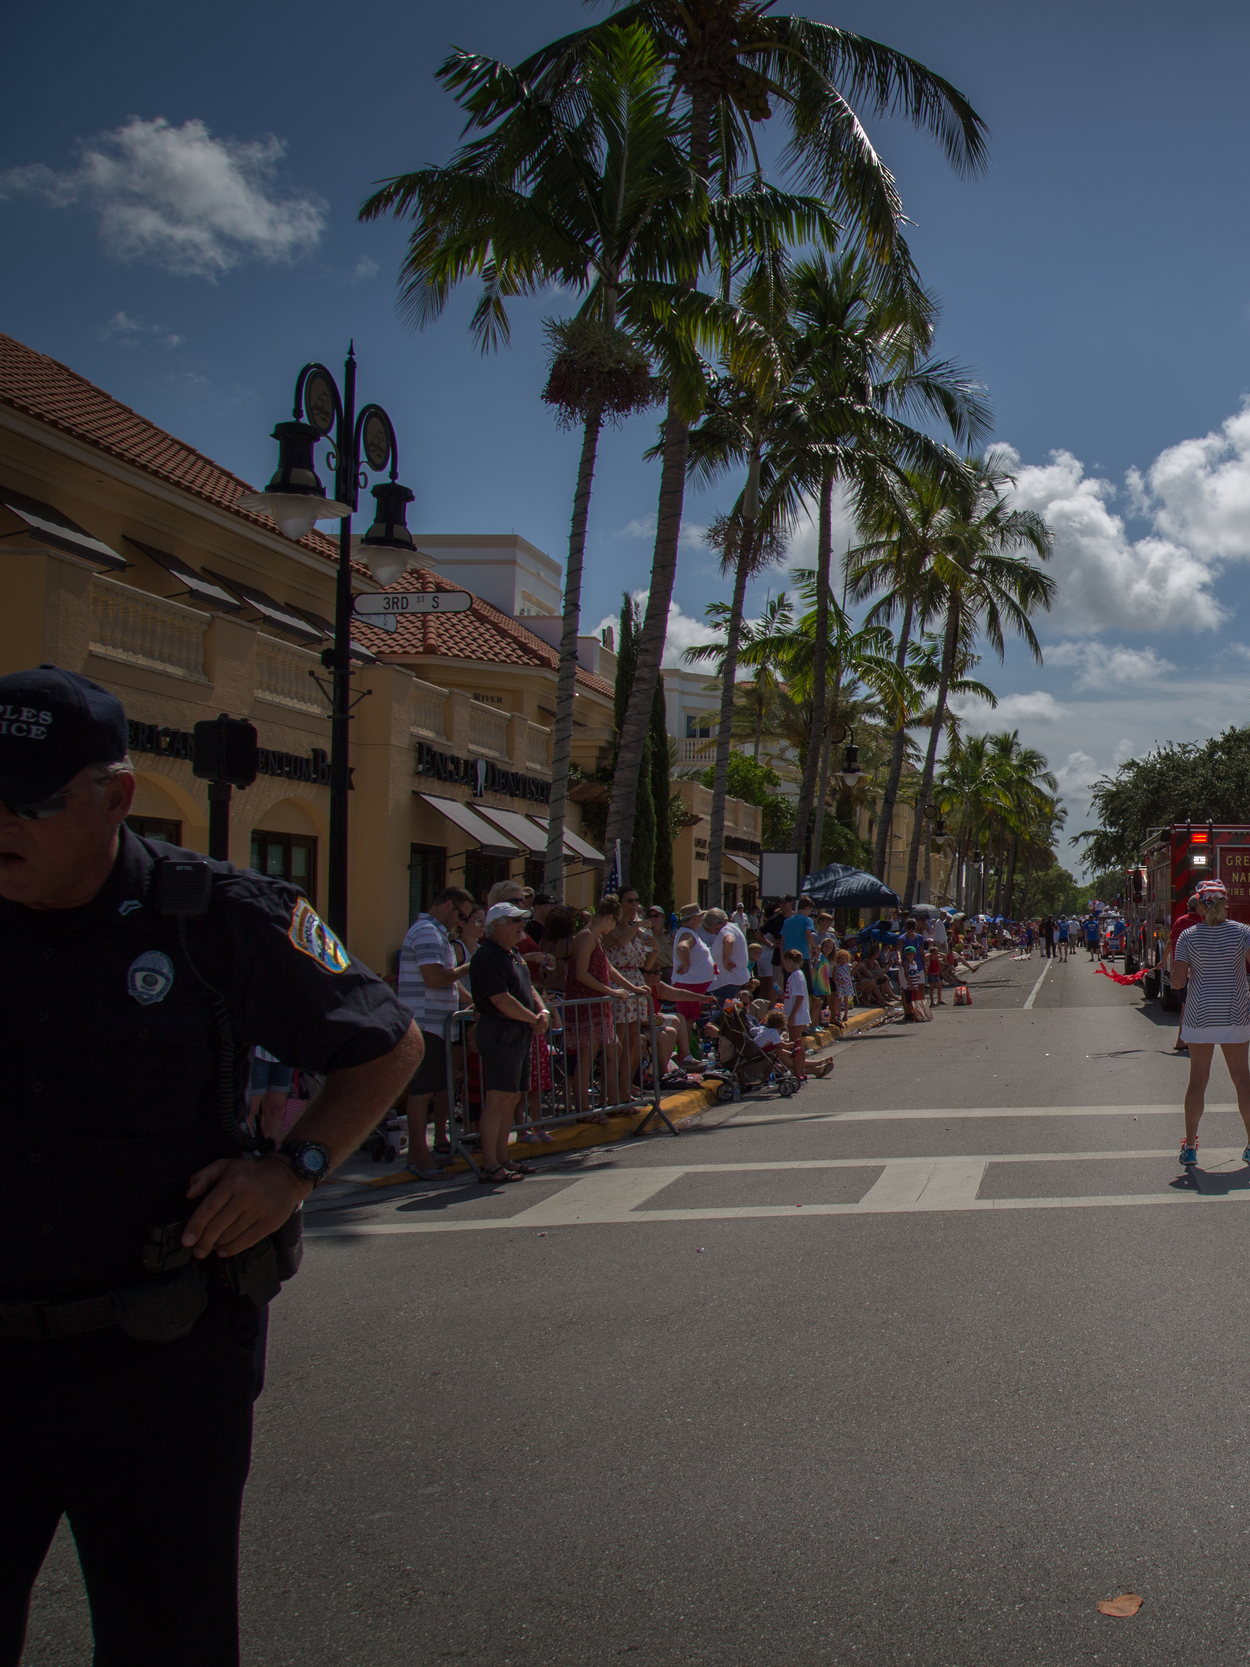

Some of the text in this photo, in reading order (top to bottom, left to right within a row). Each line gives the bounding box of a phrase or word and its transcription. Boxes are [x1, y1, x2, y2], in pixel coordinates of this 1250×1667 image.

[383, 597, 409, 610] 3RD
[432, 596, 439, 609] S
[473, 693, 503, 703] RIVER
[1226, 888, 1245, 896] FIRE
